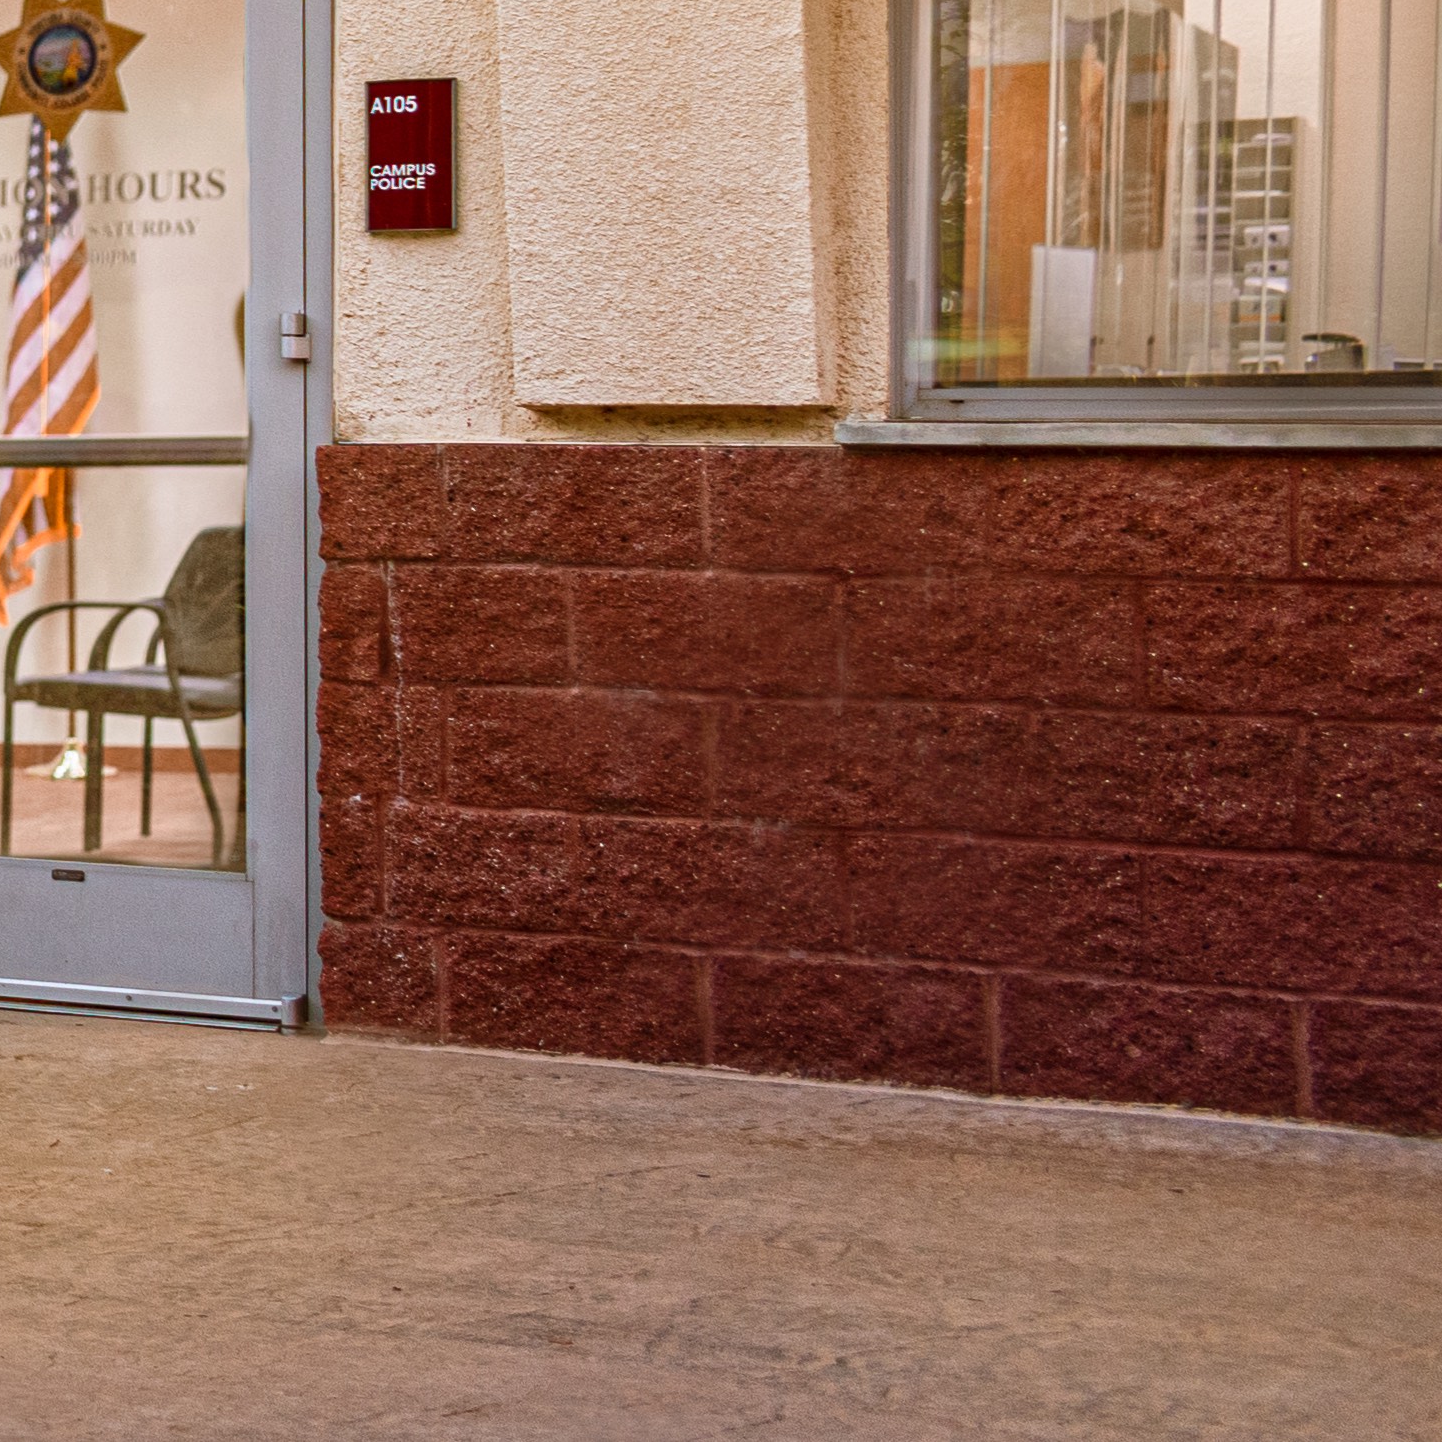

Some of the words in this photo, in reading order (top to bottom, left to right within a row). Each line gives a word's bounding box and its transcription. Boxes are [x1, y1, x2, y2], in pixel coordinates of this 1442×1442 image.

[370, 95, 418, 114] A105
[370, 162, 436, 178] CAMPUS
[86, 167, 227, 205] HOURS
[370, 176, 426, 191] POLICE
[88, 216, 200, 238] SATURDAY
